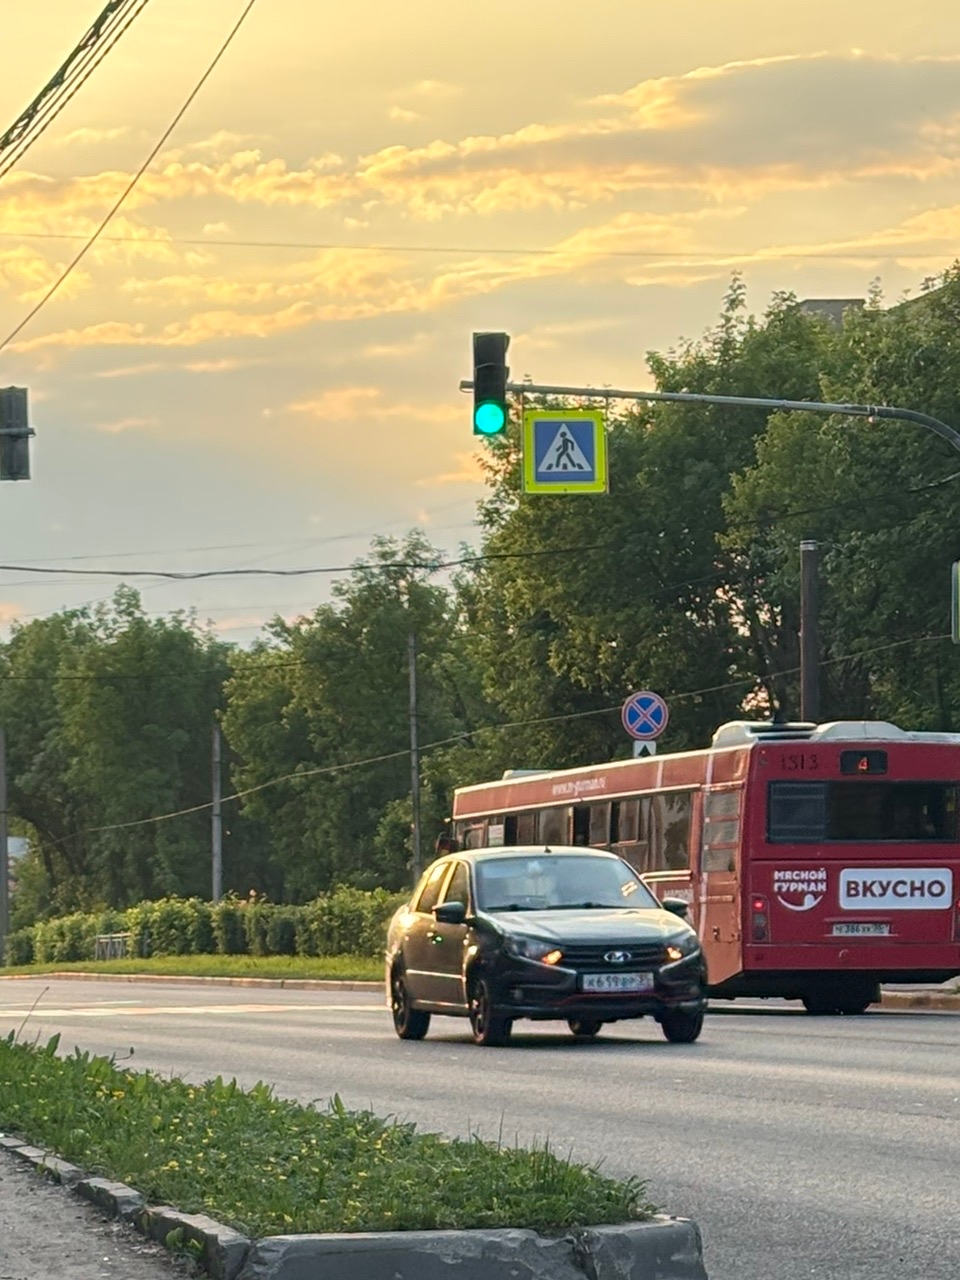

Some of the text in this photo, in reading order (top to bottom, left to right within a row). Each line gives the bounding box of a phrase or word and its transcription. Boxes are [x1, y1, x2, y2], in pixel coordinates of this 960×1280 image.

[858, 757, 868, 770] 4
[773, 867, 827, 880] МЯСНОЙ
[773, 882, 827, 893] ГУРМАН
[845, 879, 946, 898] ВКУСНО
